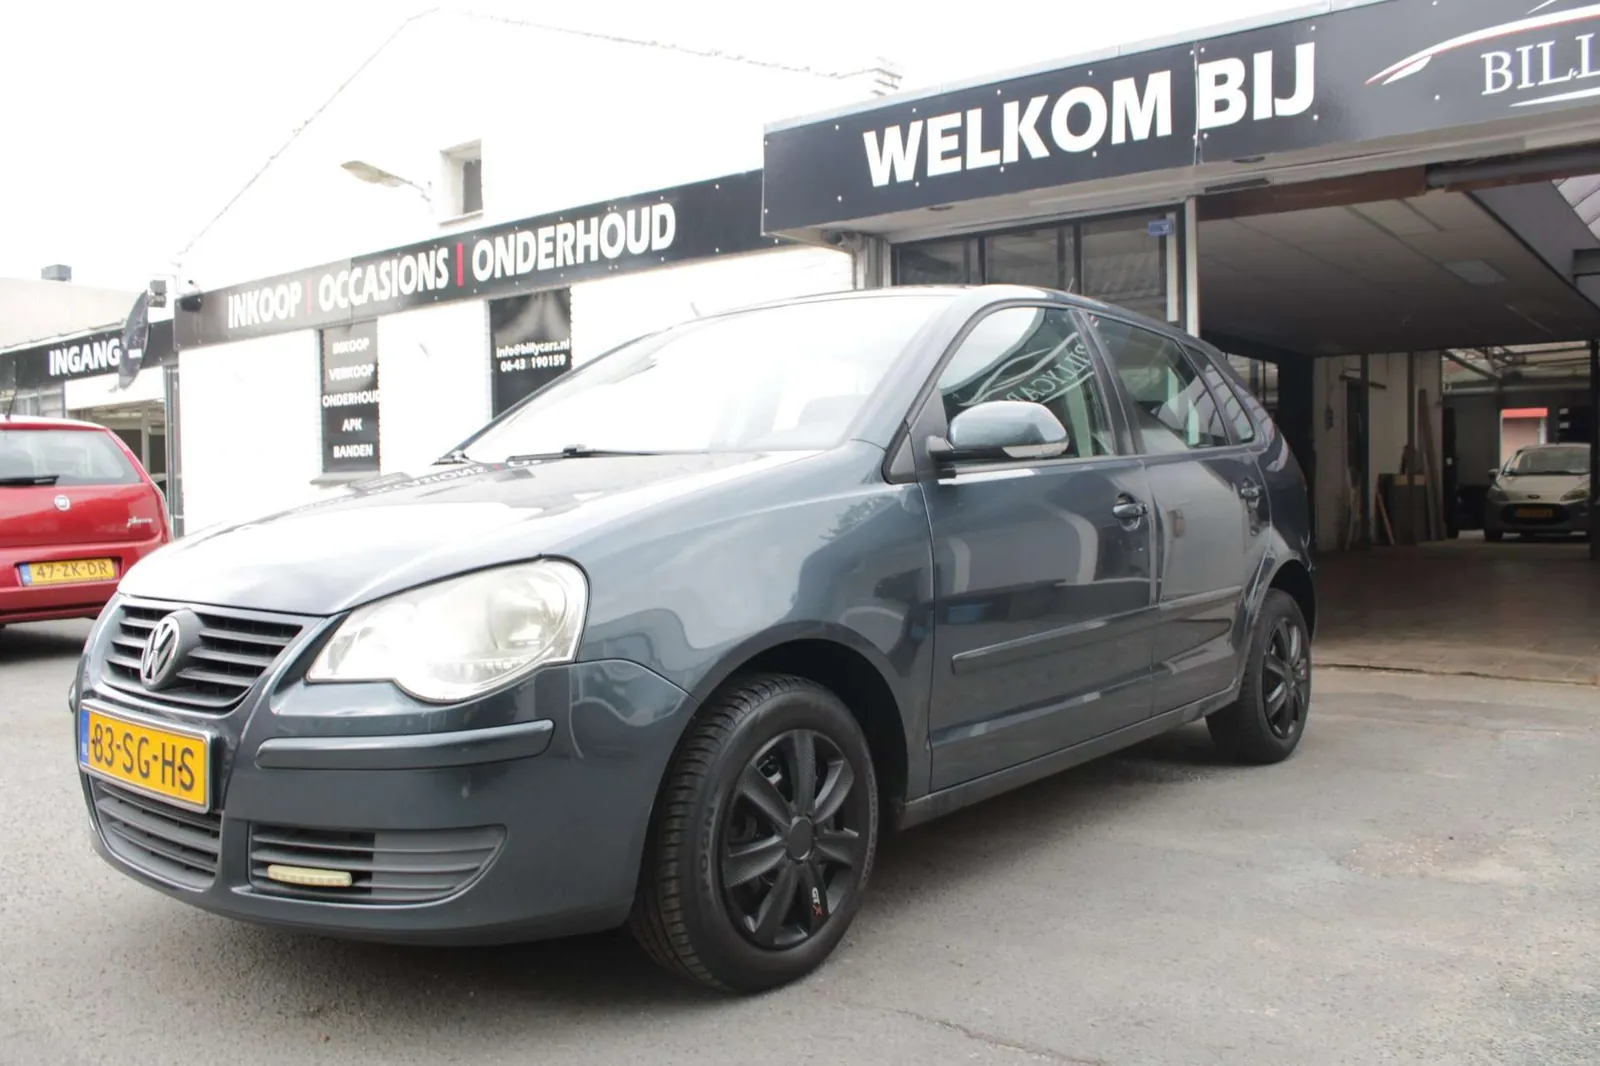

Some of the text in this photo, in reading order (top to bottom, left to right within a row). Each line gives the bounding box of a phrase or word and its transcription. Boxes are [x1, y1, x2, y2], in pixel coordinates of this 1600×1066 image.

[863, 42, 1315, 187] WELKOM BIJ
[228, 202, 676, 329] INKOOP OCCASIONS ONDERHOUD
[332, 338, 370, 355] INKOOP
[496, 338, 570, 358] info@billycars.nl
[49, 338, 120, 376] INGANG
[328, 363, 375, 380] VERKOOP
[342, 418, 363, 431] APK
[333, 444, 373, 458] BANDEN
[36, 559, 109, 579] 47-ZK-DR
[93, 723, 195, 792] 83-SG-HS
